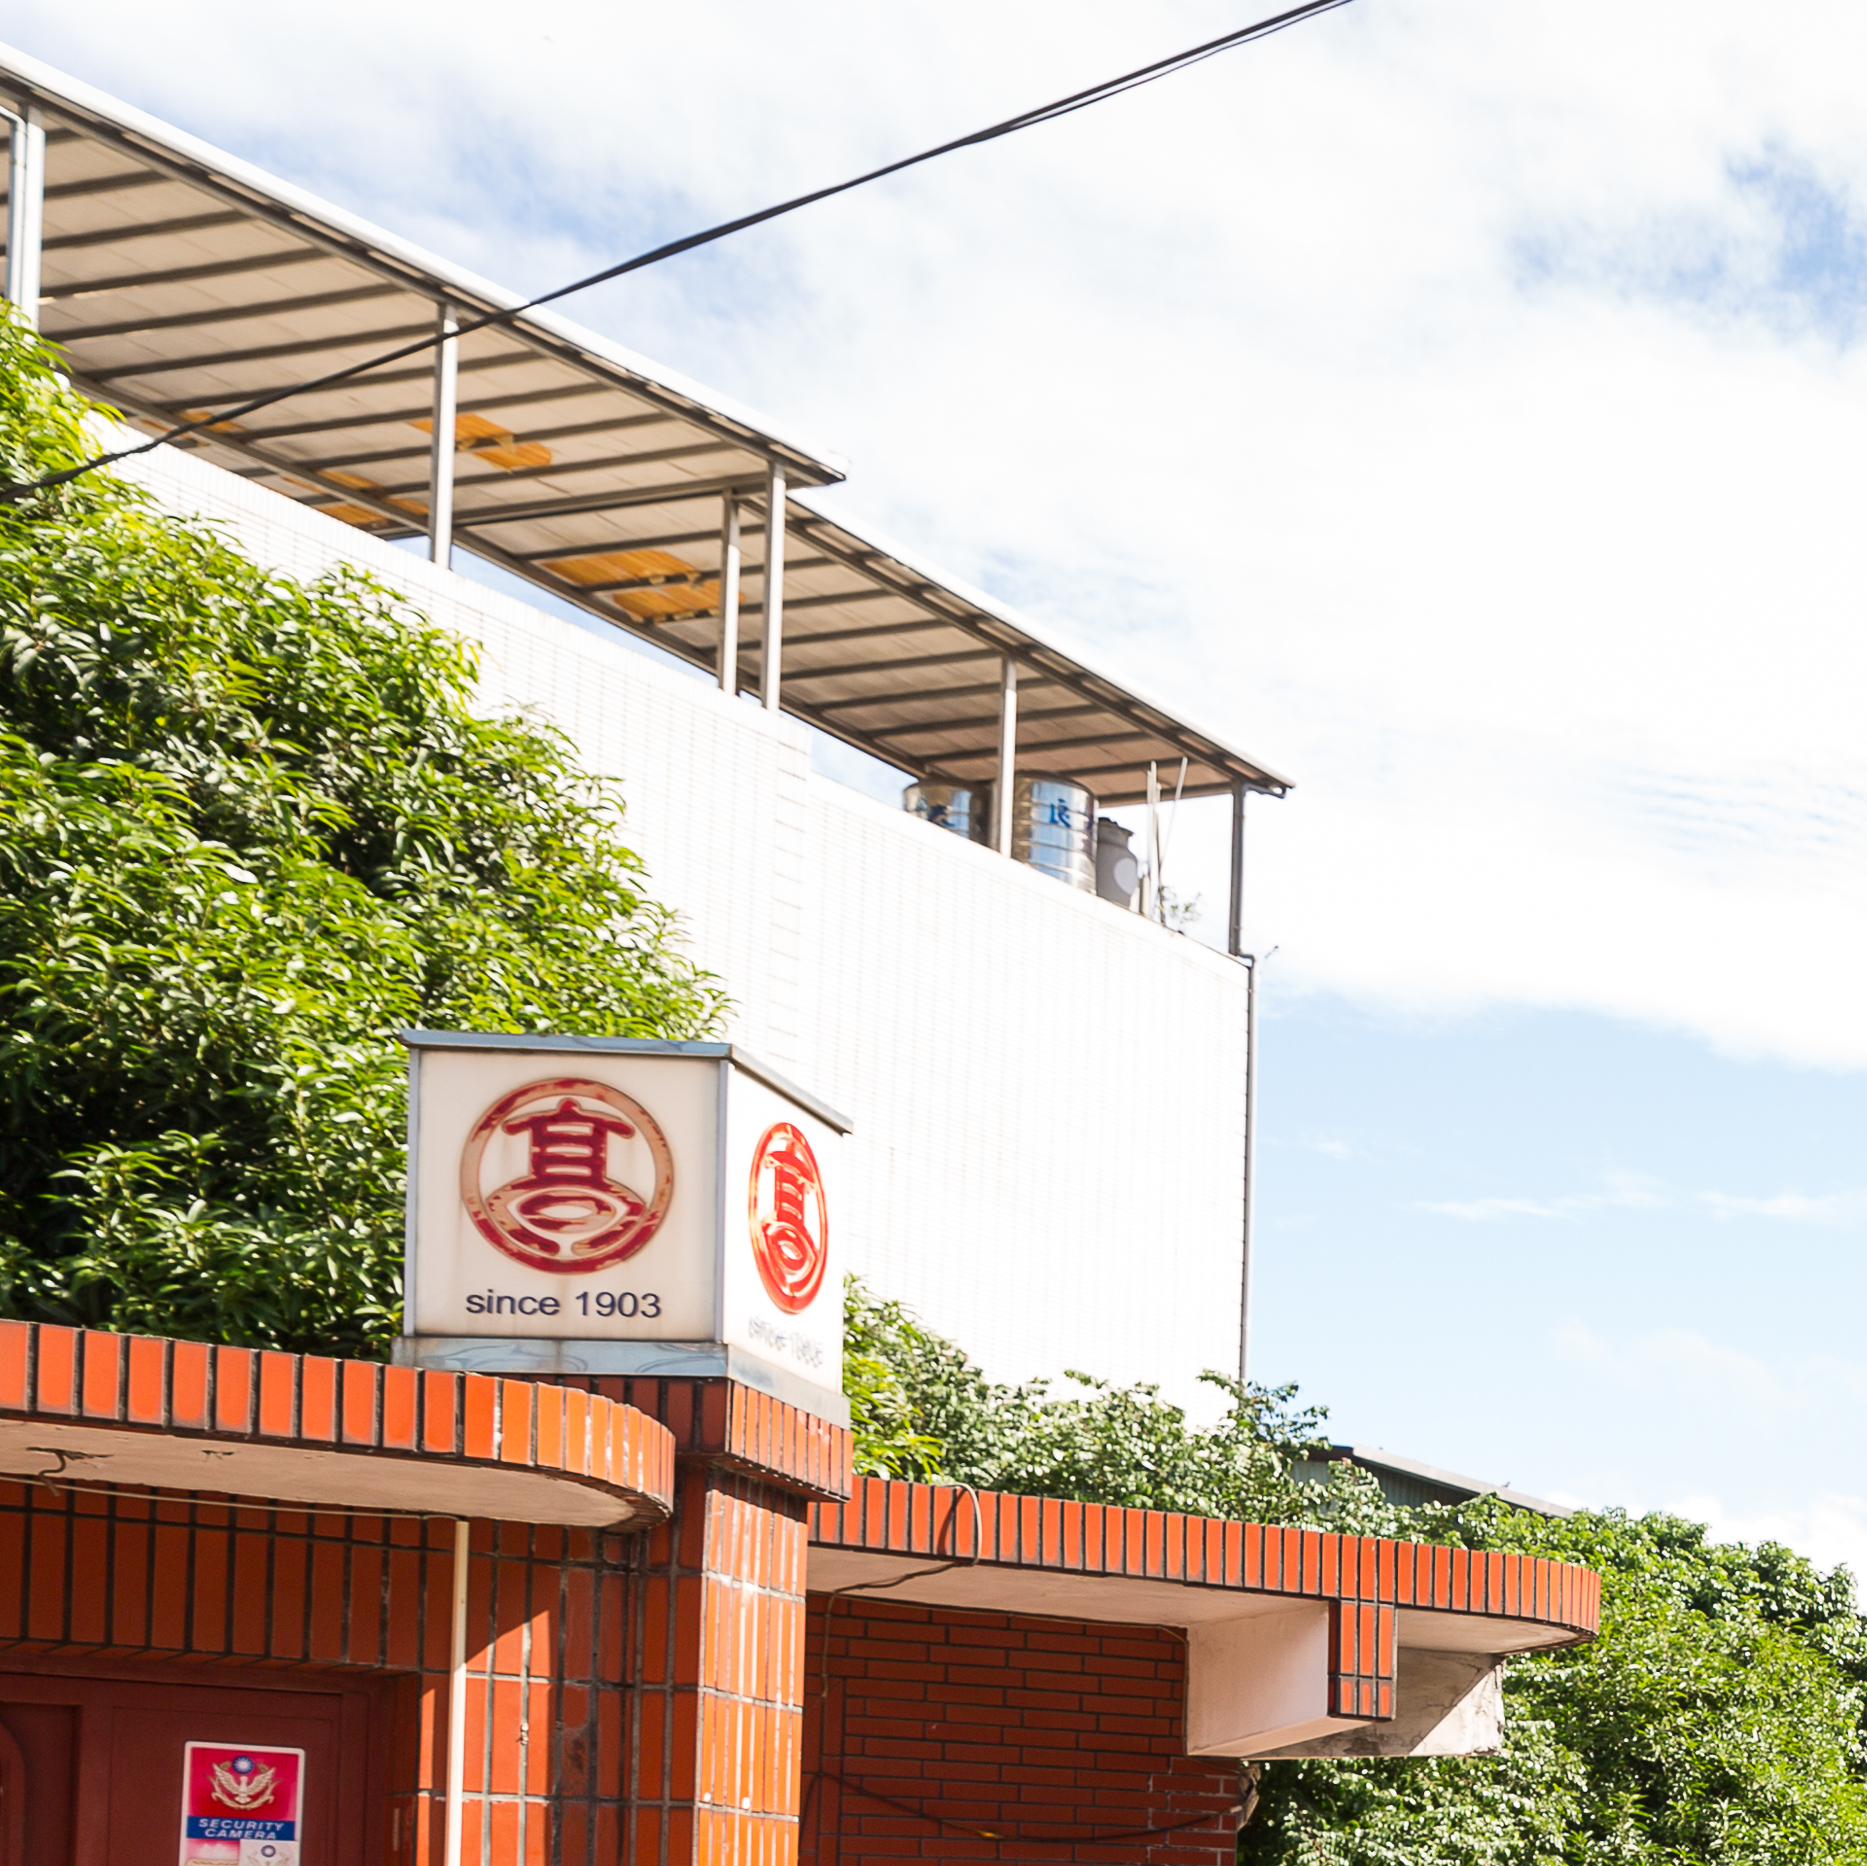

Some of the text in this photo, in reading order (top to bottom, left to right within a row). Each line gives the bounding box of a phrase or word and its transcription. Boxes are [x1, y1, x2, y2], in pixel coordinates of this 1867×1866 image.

[465, 1288, 662, 1319] since 1903
[198, 1818, 285, 1832] SECURITY
[204, 1828, 278, 1840] CAMERA
